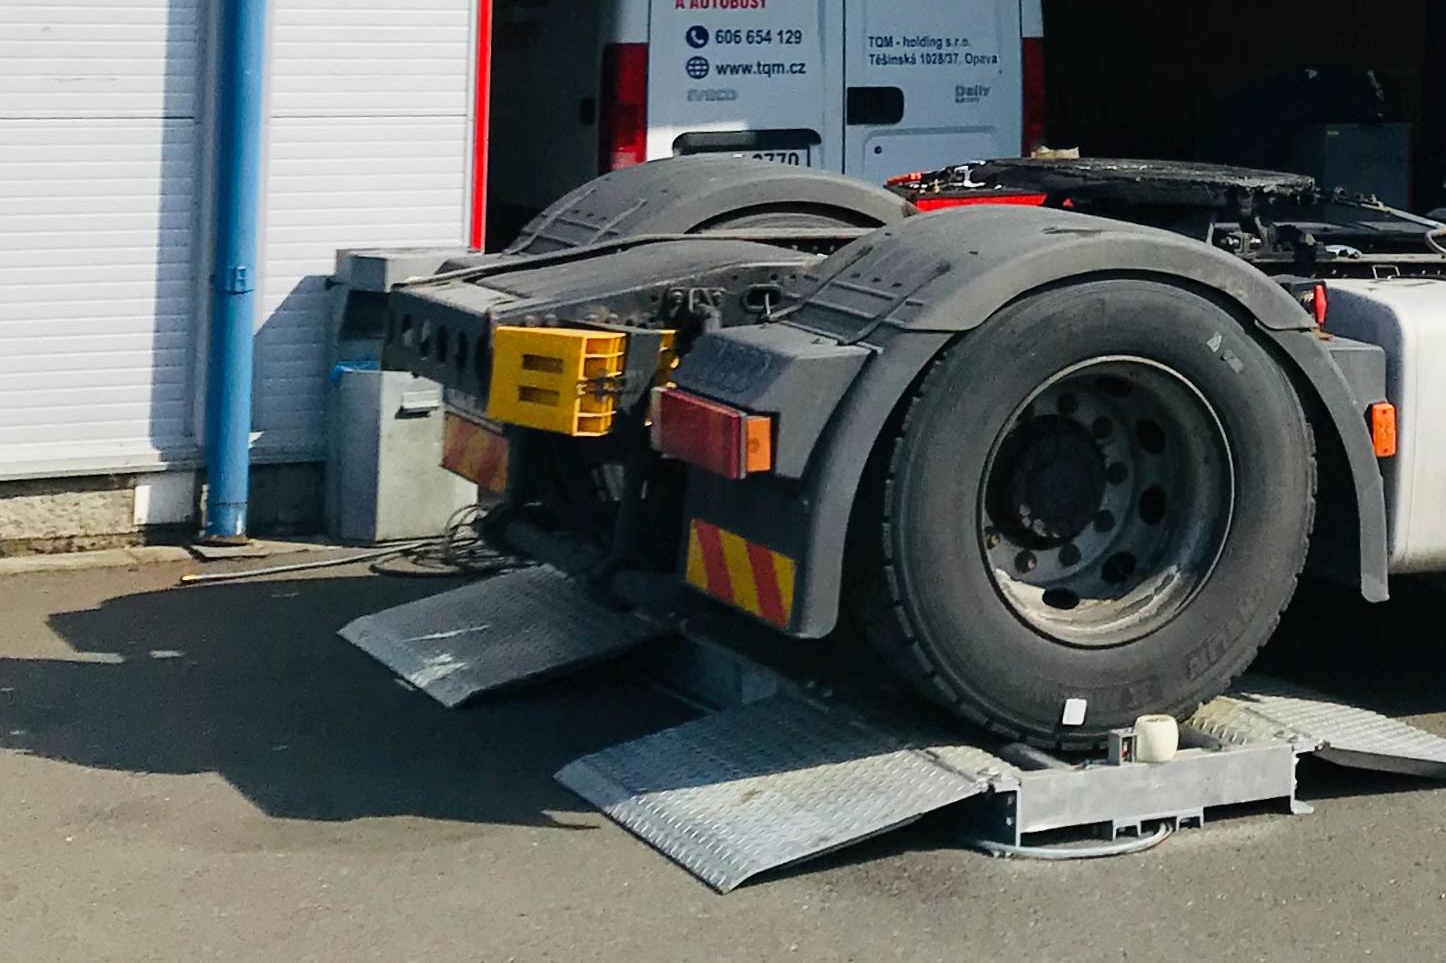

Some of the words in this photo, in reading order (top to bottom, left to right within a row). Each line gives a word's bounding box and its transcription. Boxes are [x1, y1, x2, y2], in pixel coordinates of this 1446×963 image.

[715, 29, 742, 45] 606
[746, 29, 772, 45] 654
[777, 29, 803, 45] 129
[868, 36, 893, 48] TQM
[903, 36, 942, 50] holding
[964, 52, 998, 66] Opava
[715, 60, 807, 78] www.tqm.cz
